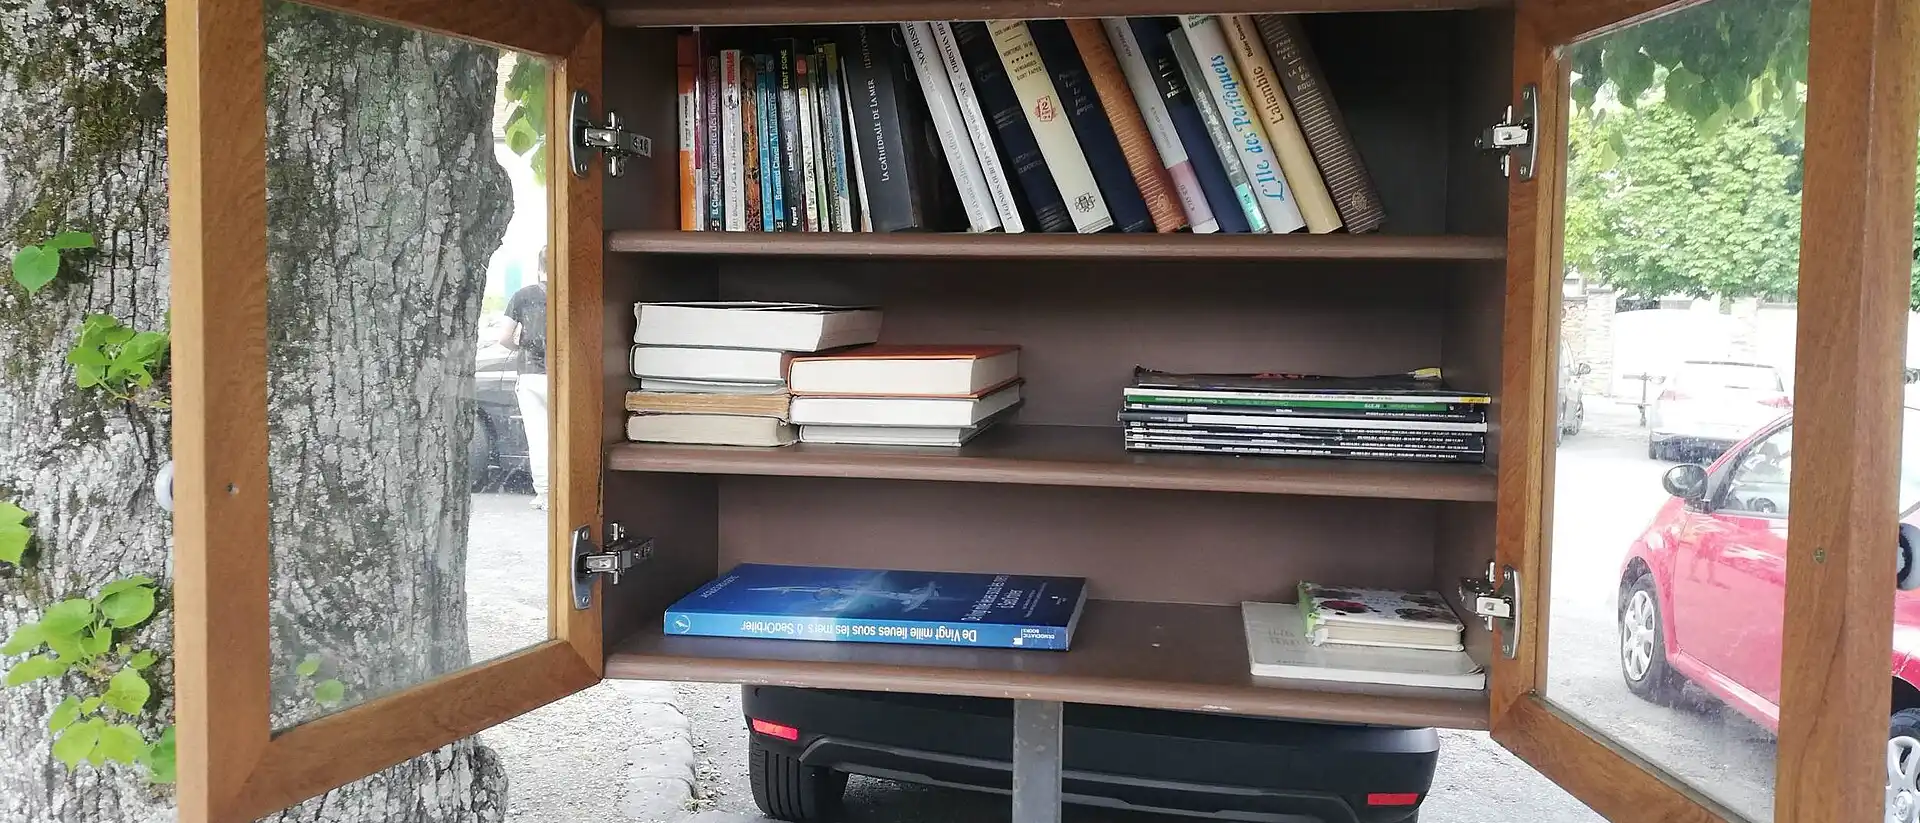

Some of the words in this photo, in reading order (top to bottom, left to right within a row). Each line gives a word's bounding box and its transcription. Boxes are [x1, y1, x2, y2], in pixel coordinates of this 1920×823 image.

[904, 21, 927, 66] NOURISSIE
[1242, 41, 1254, 58] Didier
[943, 36, 959, 74] CHRISTIAN
[867, 79, 877, 96] MER
[869, 97, 878, 107] LA
[1252, 66, 1284, 124] L'alambic
[871, 109, 880, 119] DE
[1244, 132, 1264, 155] des
[880, 170, 890, 181] LA
[740, 620, 794, 635] SeaOrbiter
[808, 623, 832, 633] mers
[836, 624, 849, 636] les
[852, 624, 876, 635] sous
[878, 625, 907, 639] lieues
[910, 627, 933, 640] mille
[935, 625, 960, 641] Vingt
[963, 629, 977, 642] De
